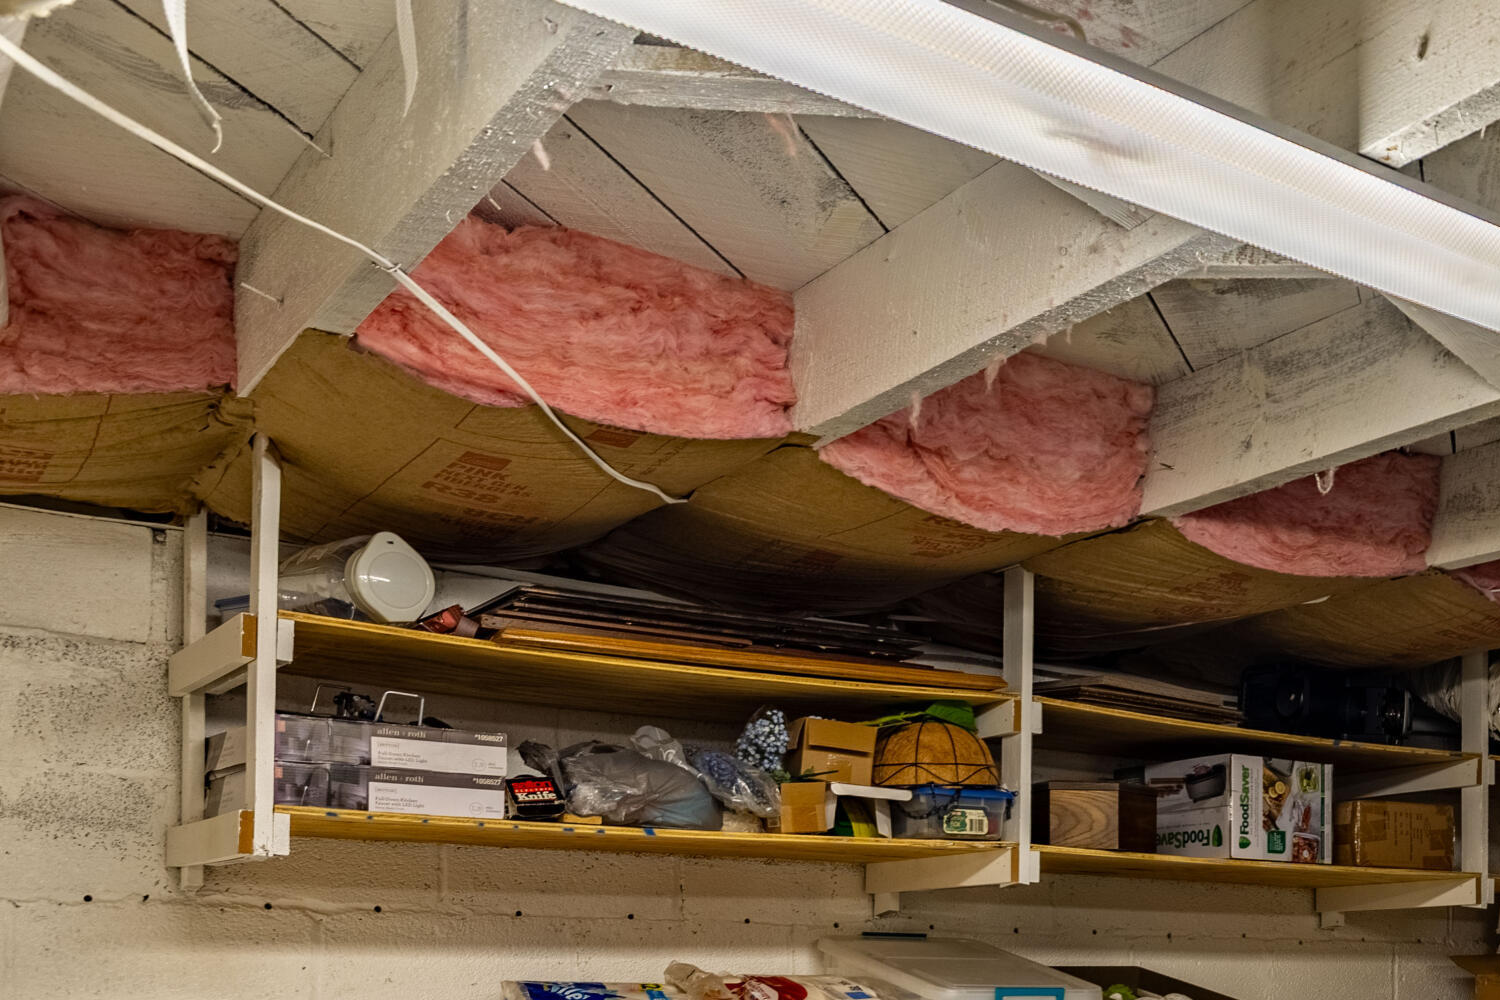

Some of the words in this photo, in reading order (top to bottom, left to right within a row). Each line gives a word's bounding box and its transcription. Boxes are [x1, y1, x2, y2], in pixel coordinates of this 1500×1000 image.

[407, 730, 426, 738] roth
[515, 791, 557, 801] Knife
[1240, 765, 1249, 835] FoodSaver
[1155, 829, 1210, 849] FoodSave
